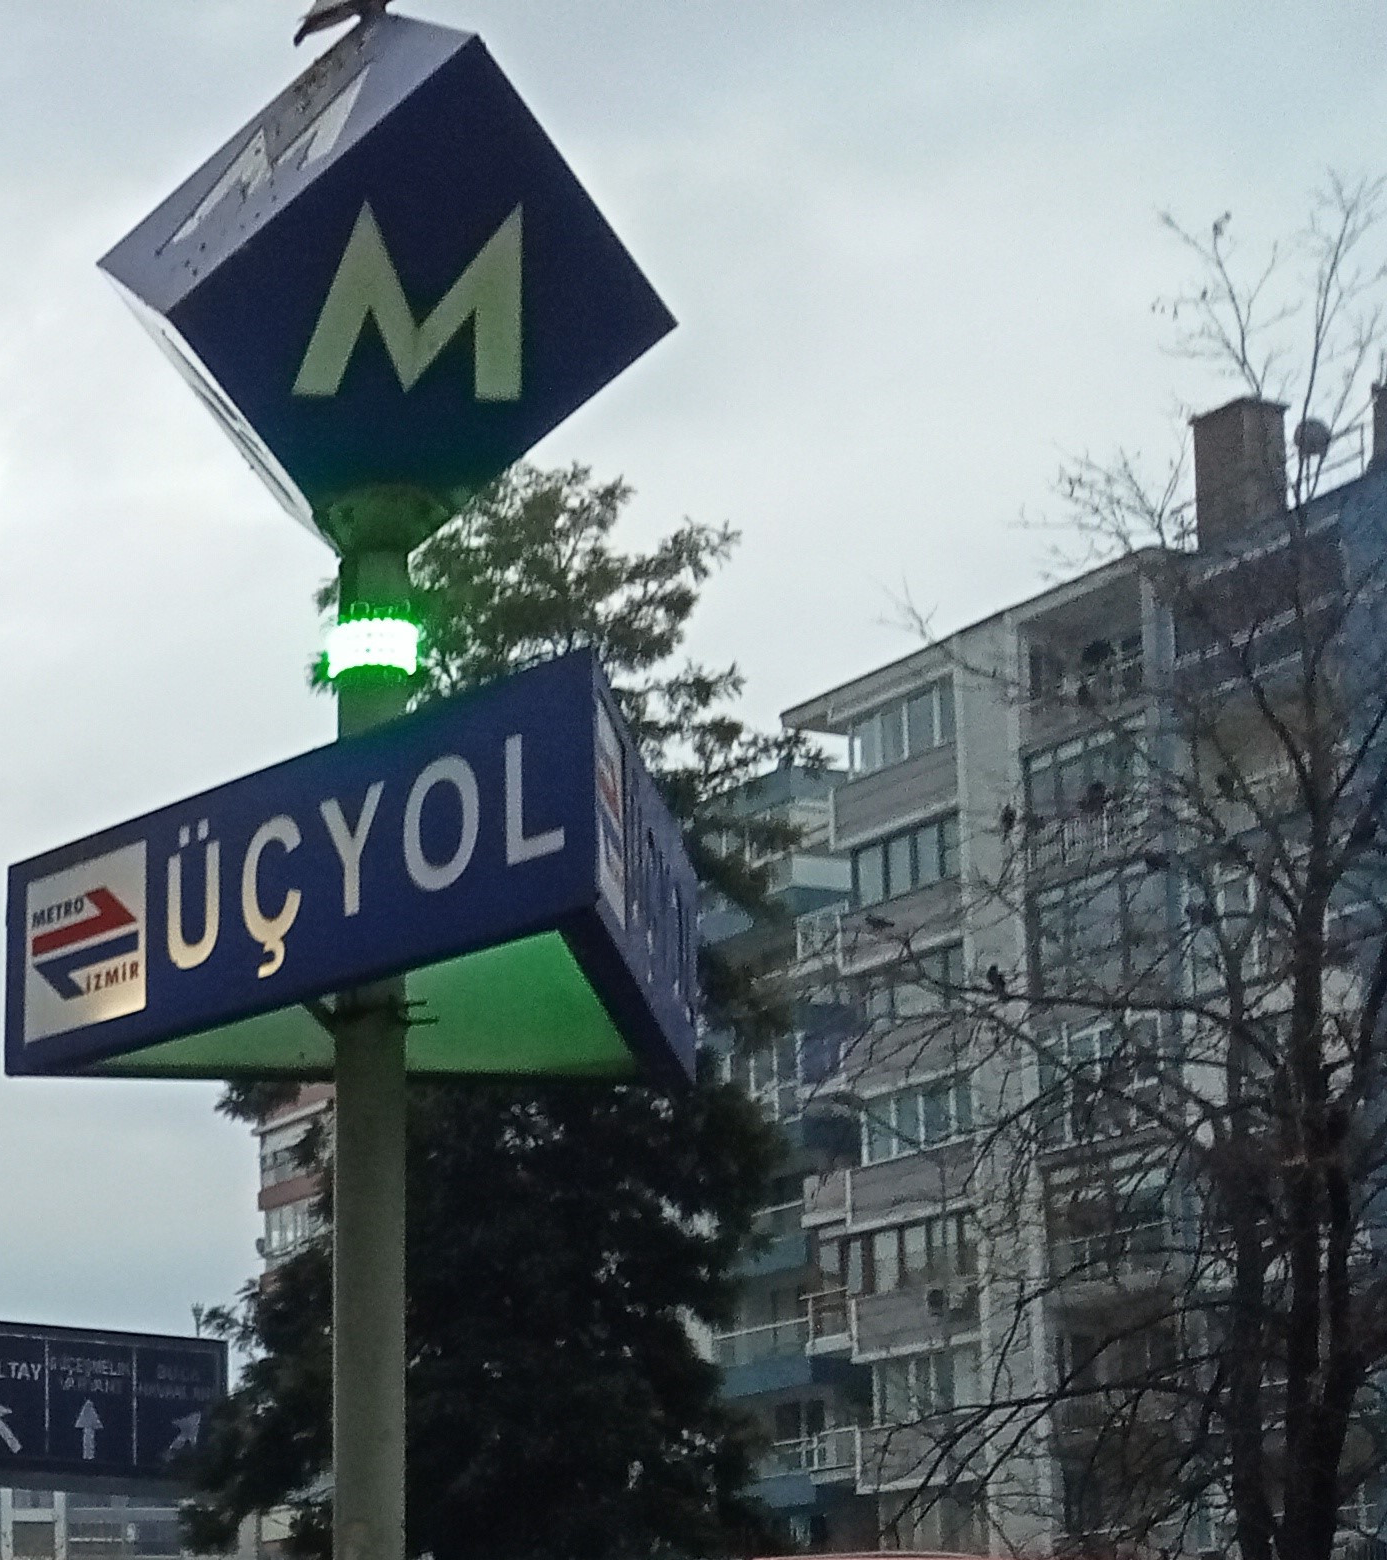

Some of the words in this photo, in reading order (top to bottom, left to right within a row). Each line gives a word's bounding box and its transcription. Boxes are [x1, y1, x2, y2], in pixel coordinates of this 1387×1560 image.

[291, 201, 524, 402] M
[32, 898, 84, 928] METRO
[167, 733, 565, 979] ÜÇYOL
[85, 961, 139, 995] İZMİR
